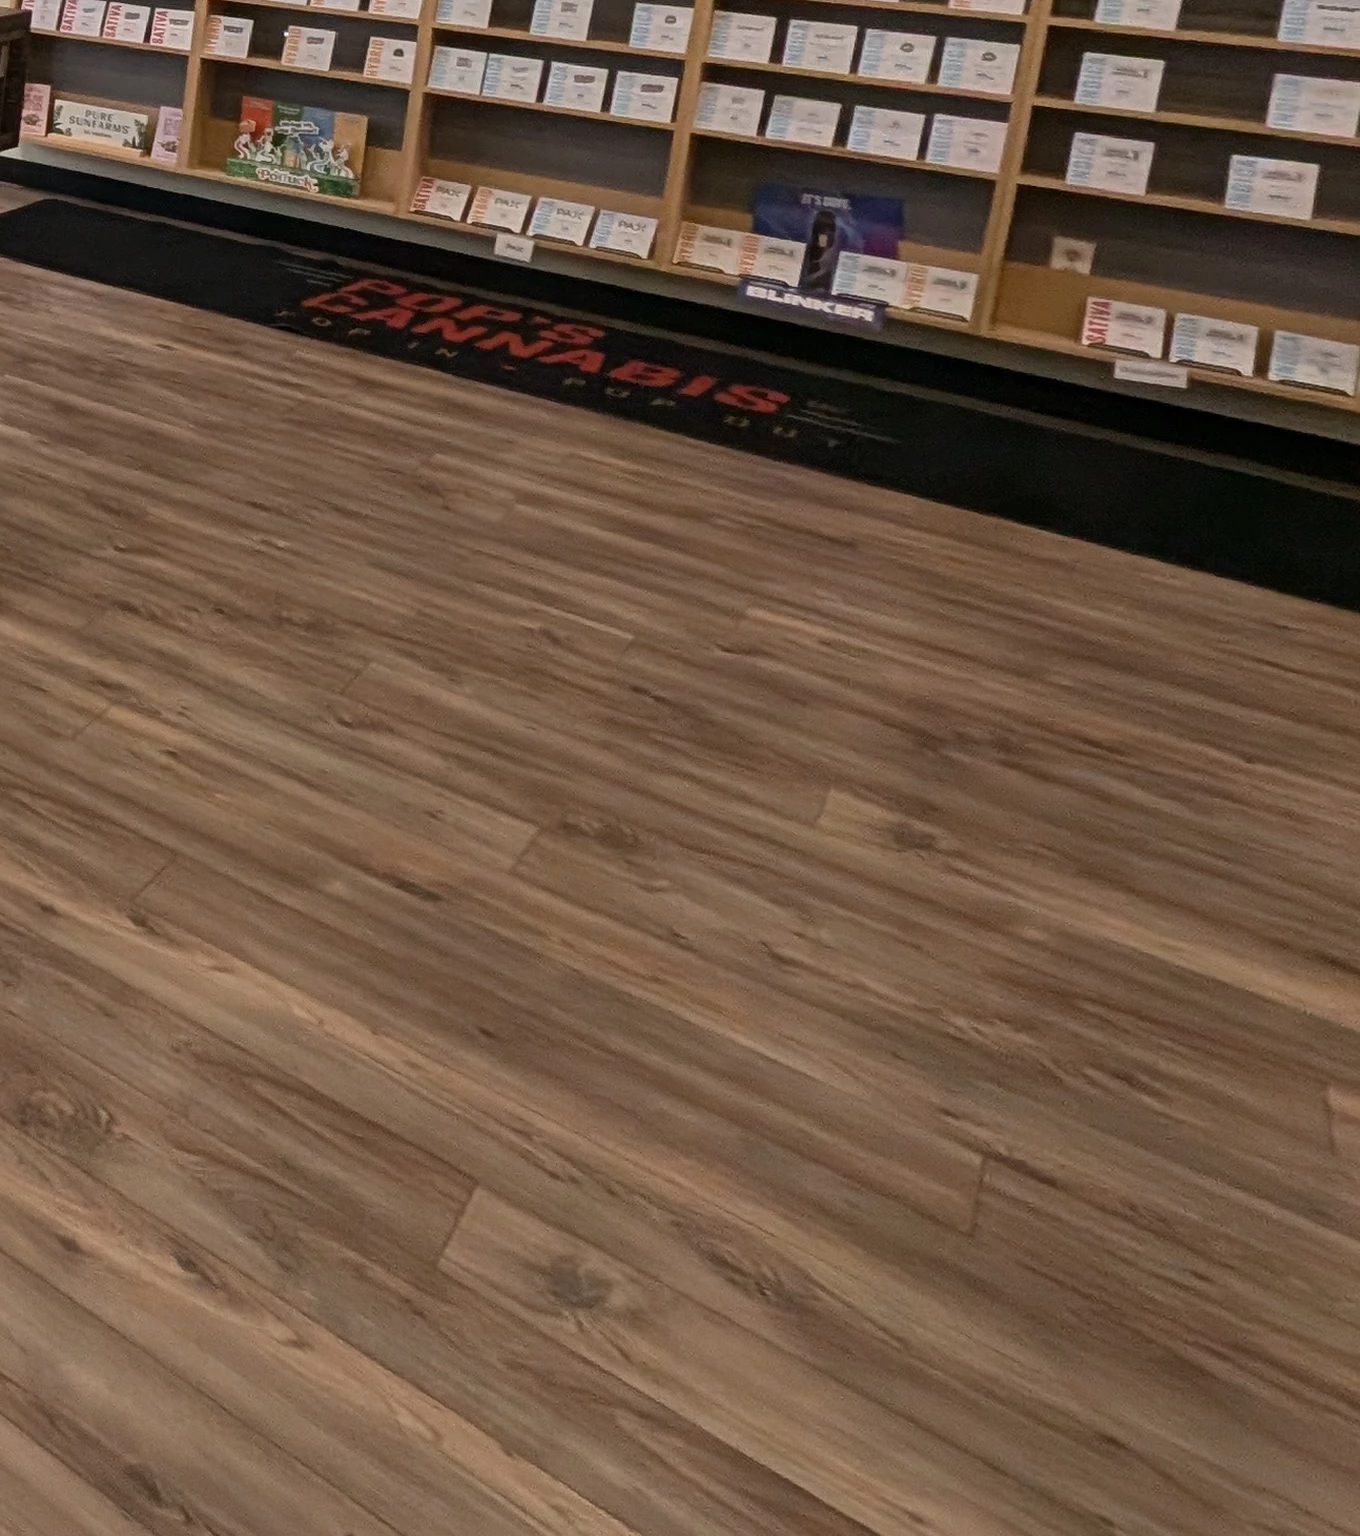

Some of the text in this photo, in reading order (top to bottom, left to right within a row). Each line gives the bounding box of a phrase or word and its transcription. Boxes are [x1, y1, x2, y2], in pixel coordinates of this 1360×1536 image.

[62, 0, 78, 31] SATIVA
[105, 5, 122, 37] SATIVA
[153, 10, 168, 44] SATIVA
[69, 116, 130, 134] SUNFARMS
[85, 109, 113, 121] PURE
[412, 177, 434, 210] SATIVA
[345, 278, 606, 344] POP'S
[746, 286, 874, 321] BLINKER
[1087, 299, 1111, 343] SATIVA
[302, 292, 792, 413] CANNABIS
